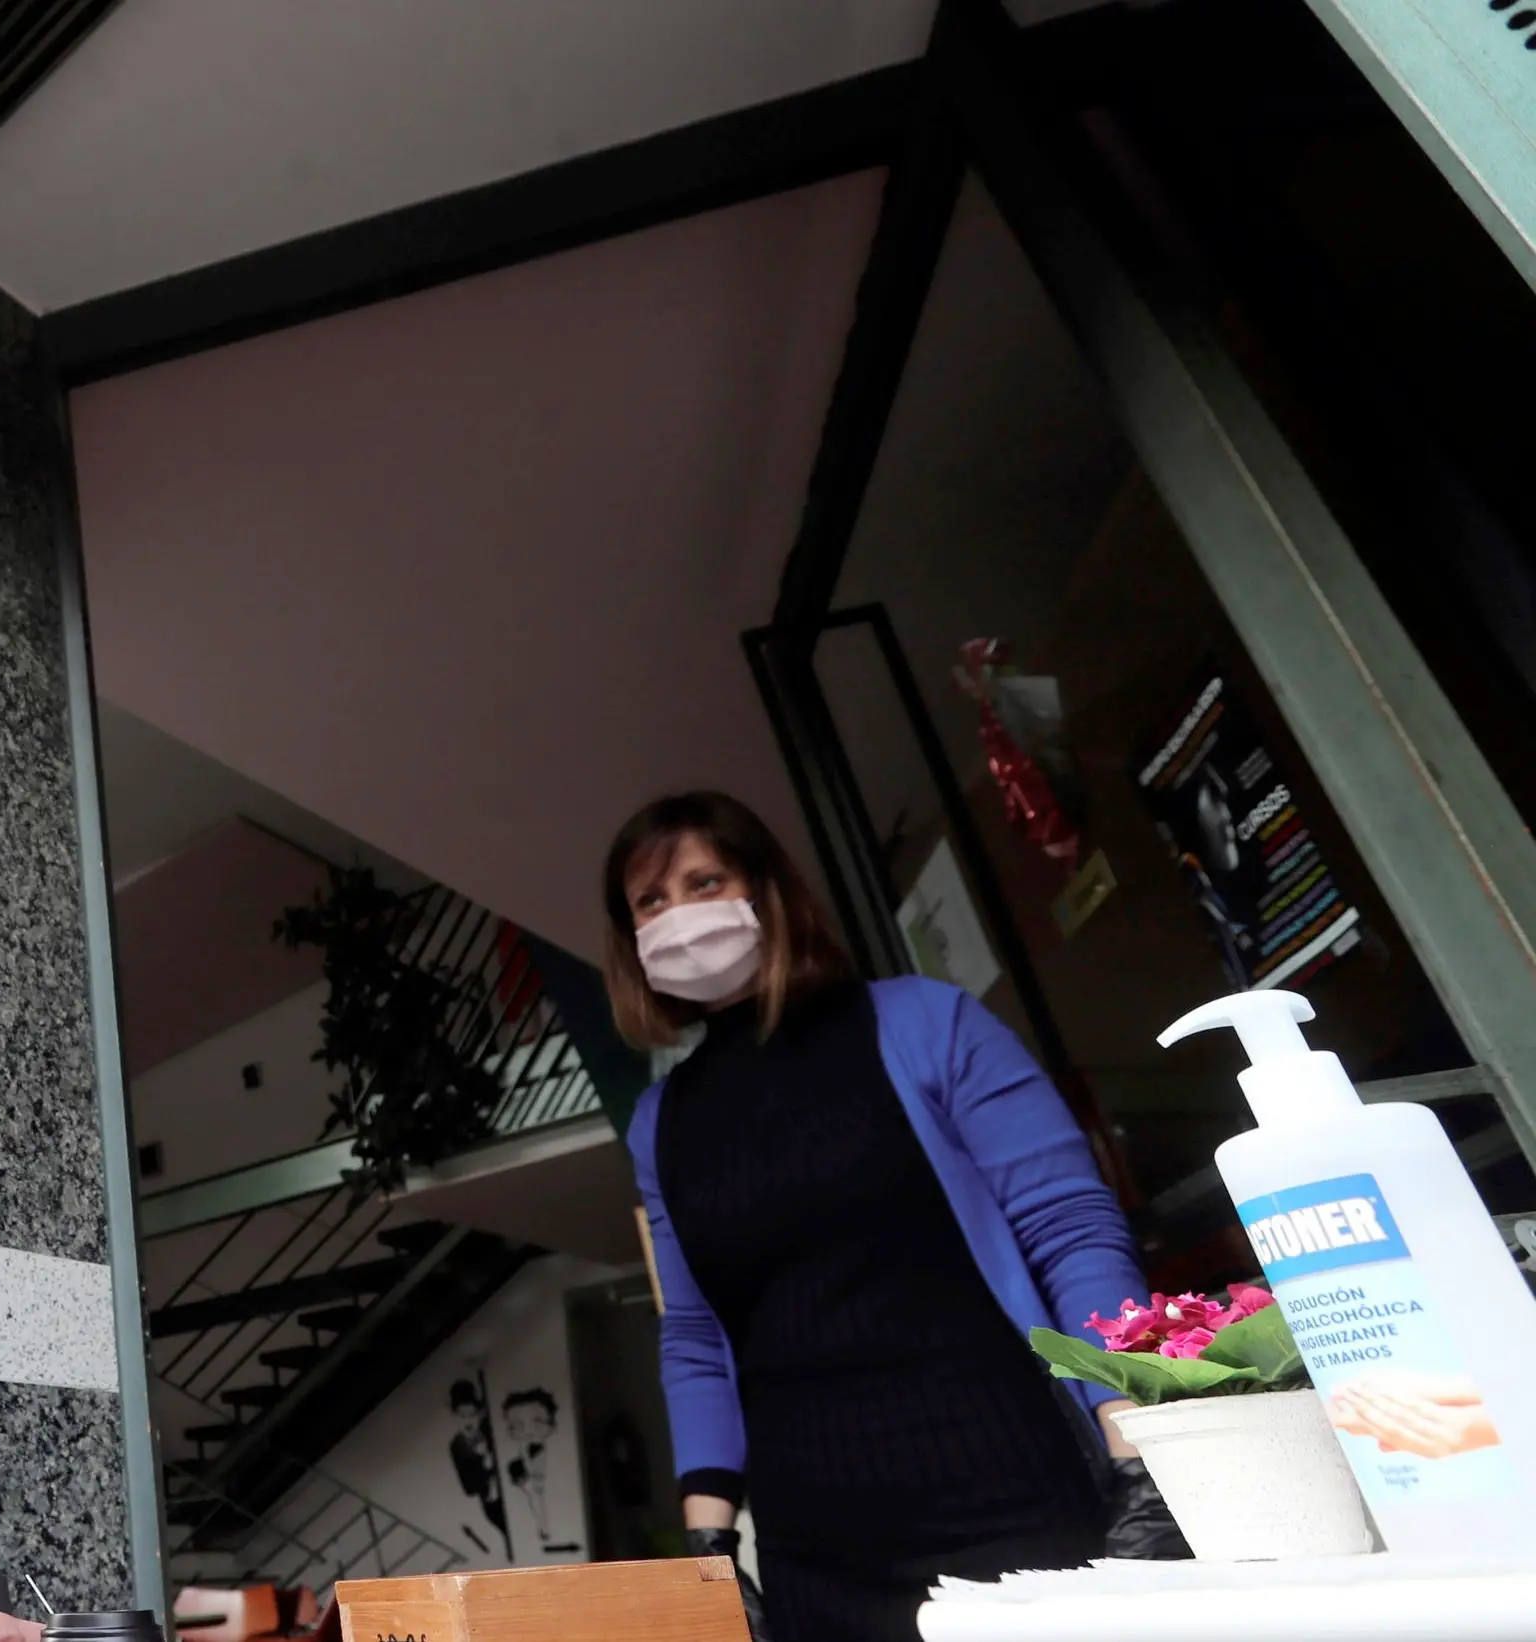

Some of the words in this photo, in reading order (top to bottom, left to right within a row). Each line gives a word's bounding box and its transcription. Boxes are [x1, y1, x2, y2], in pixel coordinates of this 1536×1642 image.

[1287, 1286, 1366, 1314] SOLUCIÓN
[1299, 1322, 1399, 1351] HIGIENIZANTE
[1311, 1354, 1327, 1369] DE
[1327, 1344, 1393, 1367] MANOS
